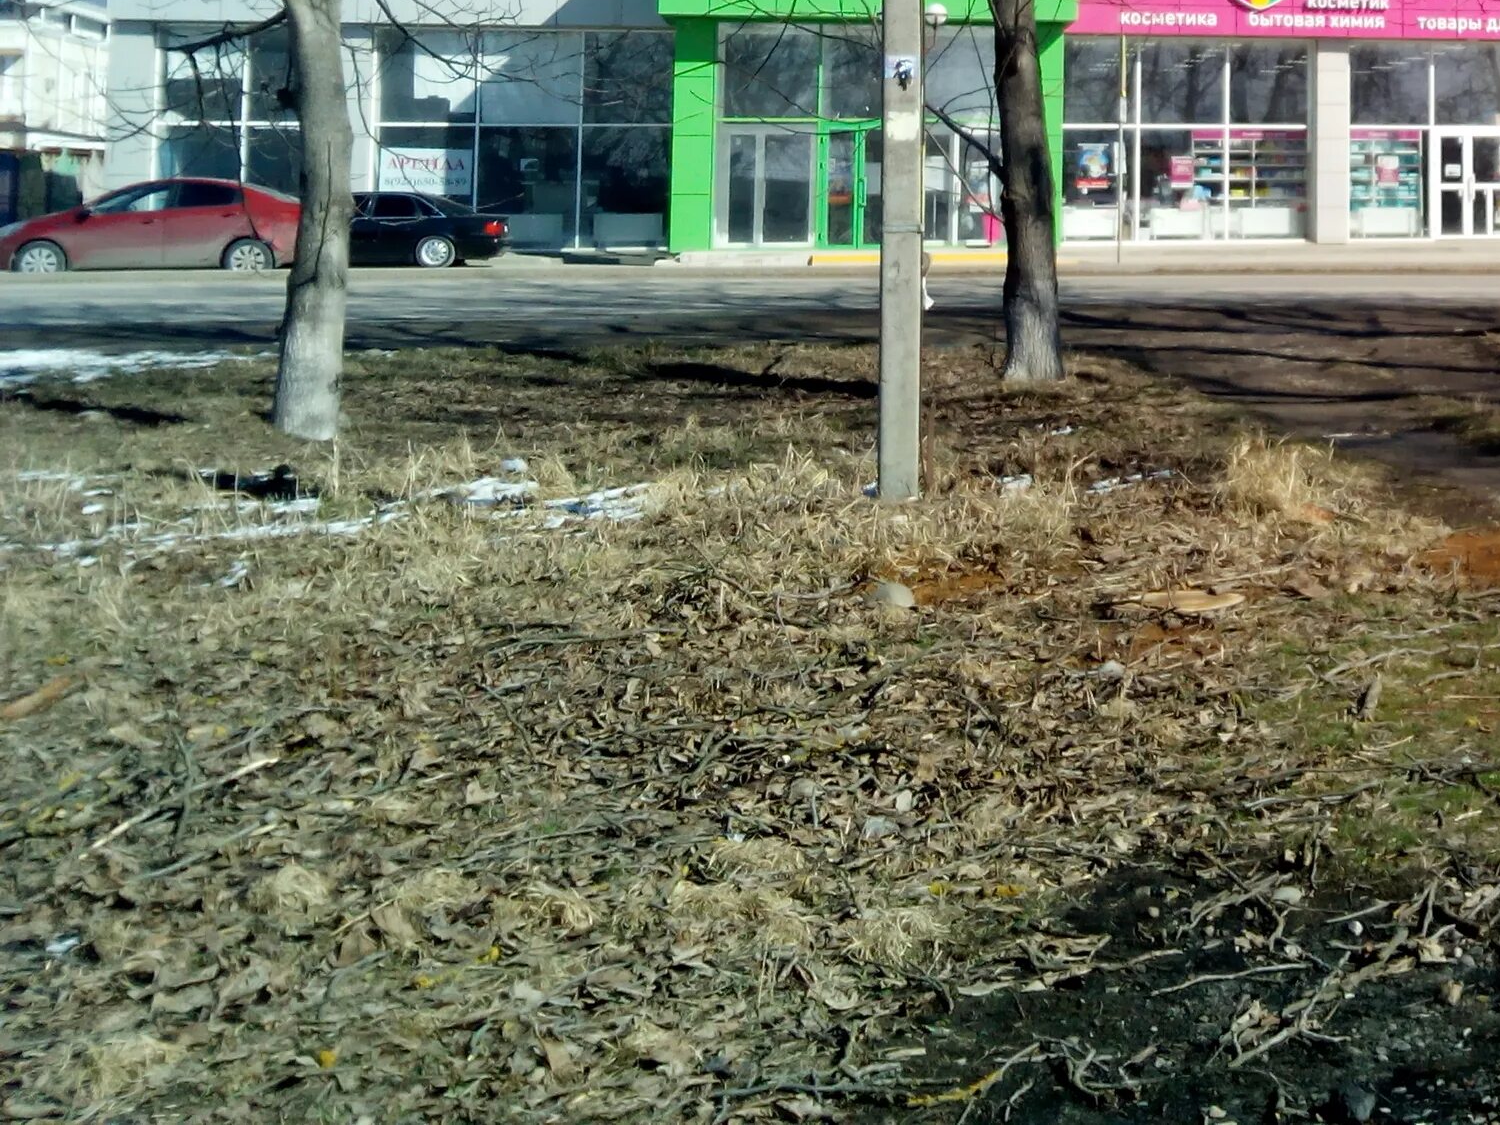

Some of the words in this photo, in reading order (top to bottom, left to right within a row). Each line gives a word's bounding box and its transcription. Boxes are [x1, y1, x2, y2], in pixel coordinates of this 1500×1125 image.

[1120, 12, 1218, 27] косметика
[1248, 12, 1325, 28] бытовая
[1330, 16, 1385, 29] химия
[1417, 17, 1481, 34] товары
